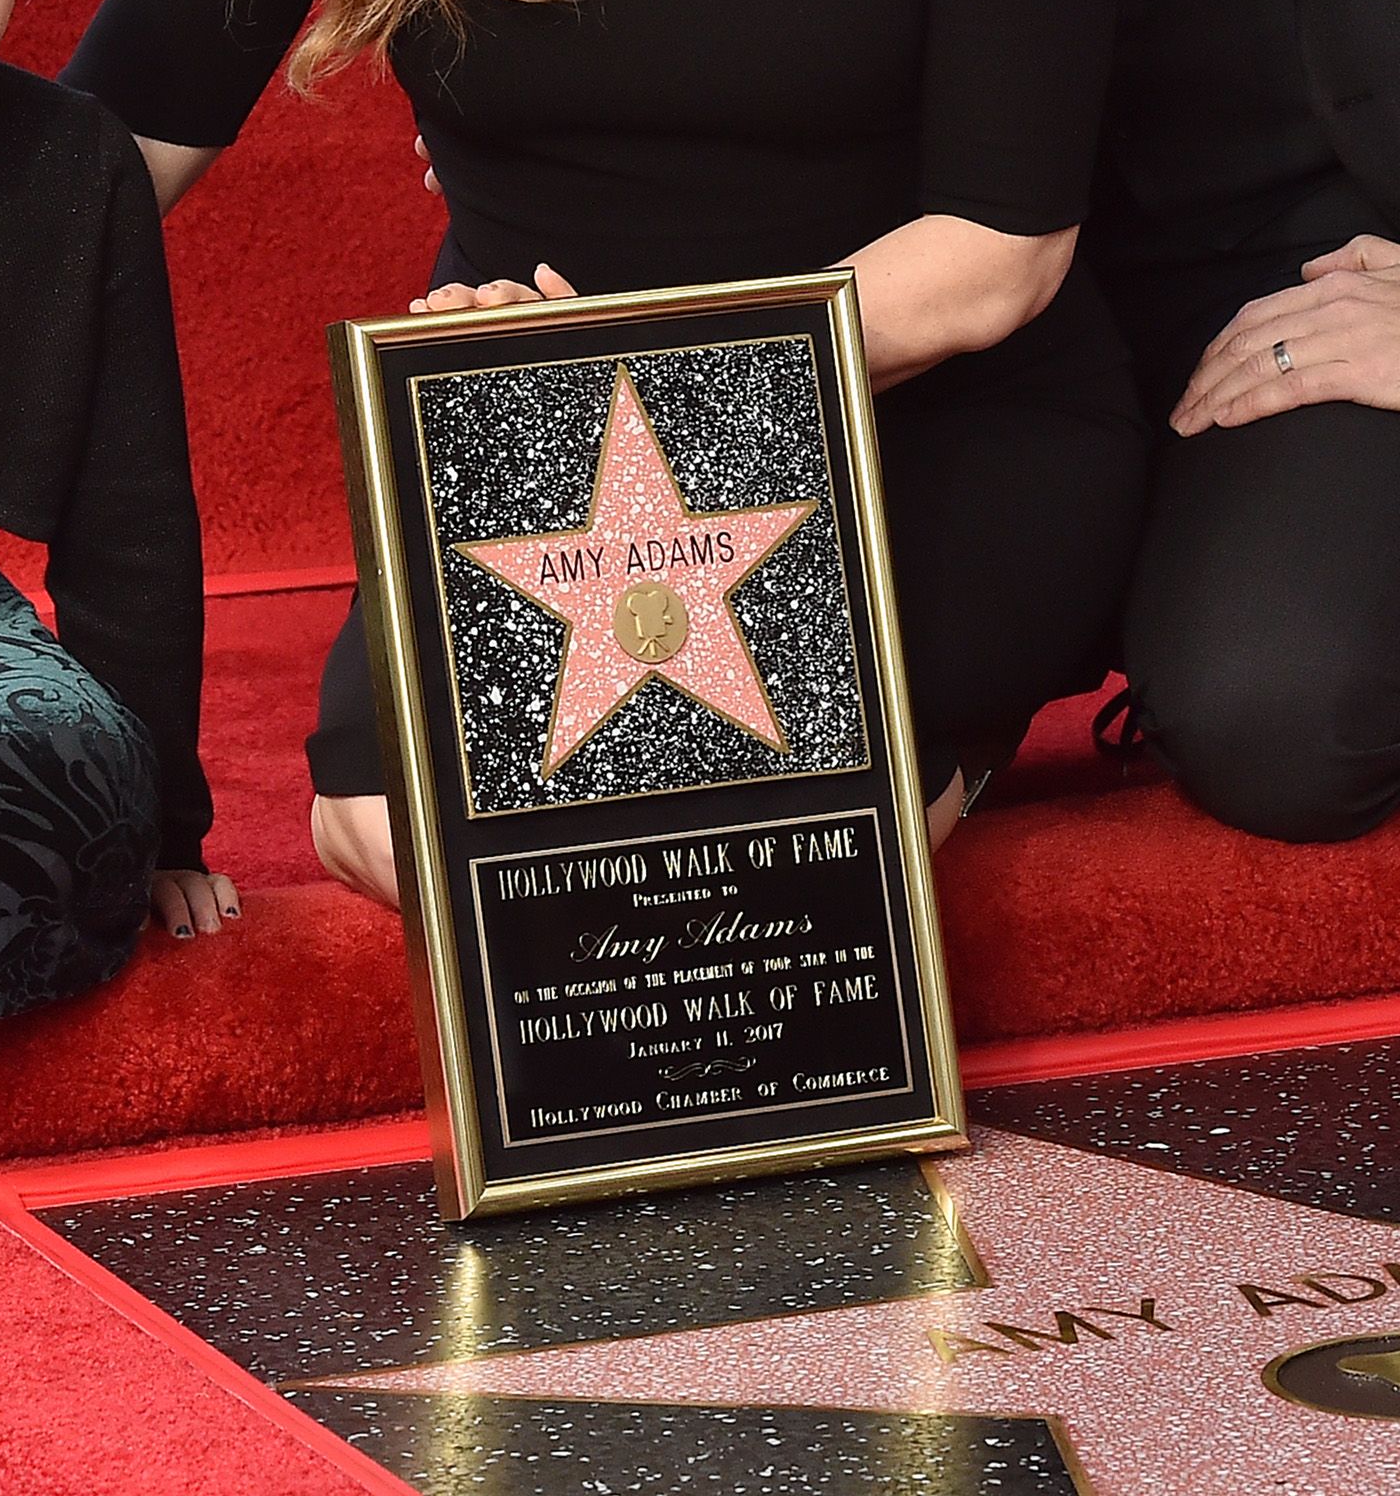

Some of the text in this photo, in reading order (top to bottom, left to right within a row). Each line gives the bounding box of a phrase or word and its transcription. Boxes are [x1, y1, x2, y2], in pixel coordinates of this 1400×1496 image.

[539, 531, 735, 586] AMY ADAMS
[498, 827, 859, 900] HOLLYWOOD WALK OF FAME
[570, 910, 813, 964] Amy Adams
[514, 945, 875, 1004] ON THE OCCASION OF THE PLACEMENT OF YOUR STAR IN THE
[519, 974, 879, 1044] HOLLYWOOD WALK OF FAME
[743, 1022, 784, 1044] 2017
[925, 1298, 1174, 1362] AMY
